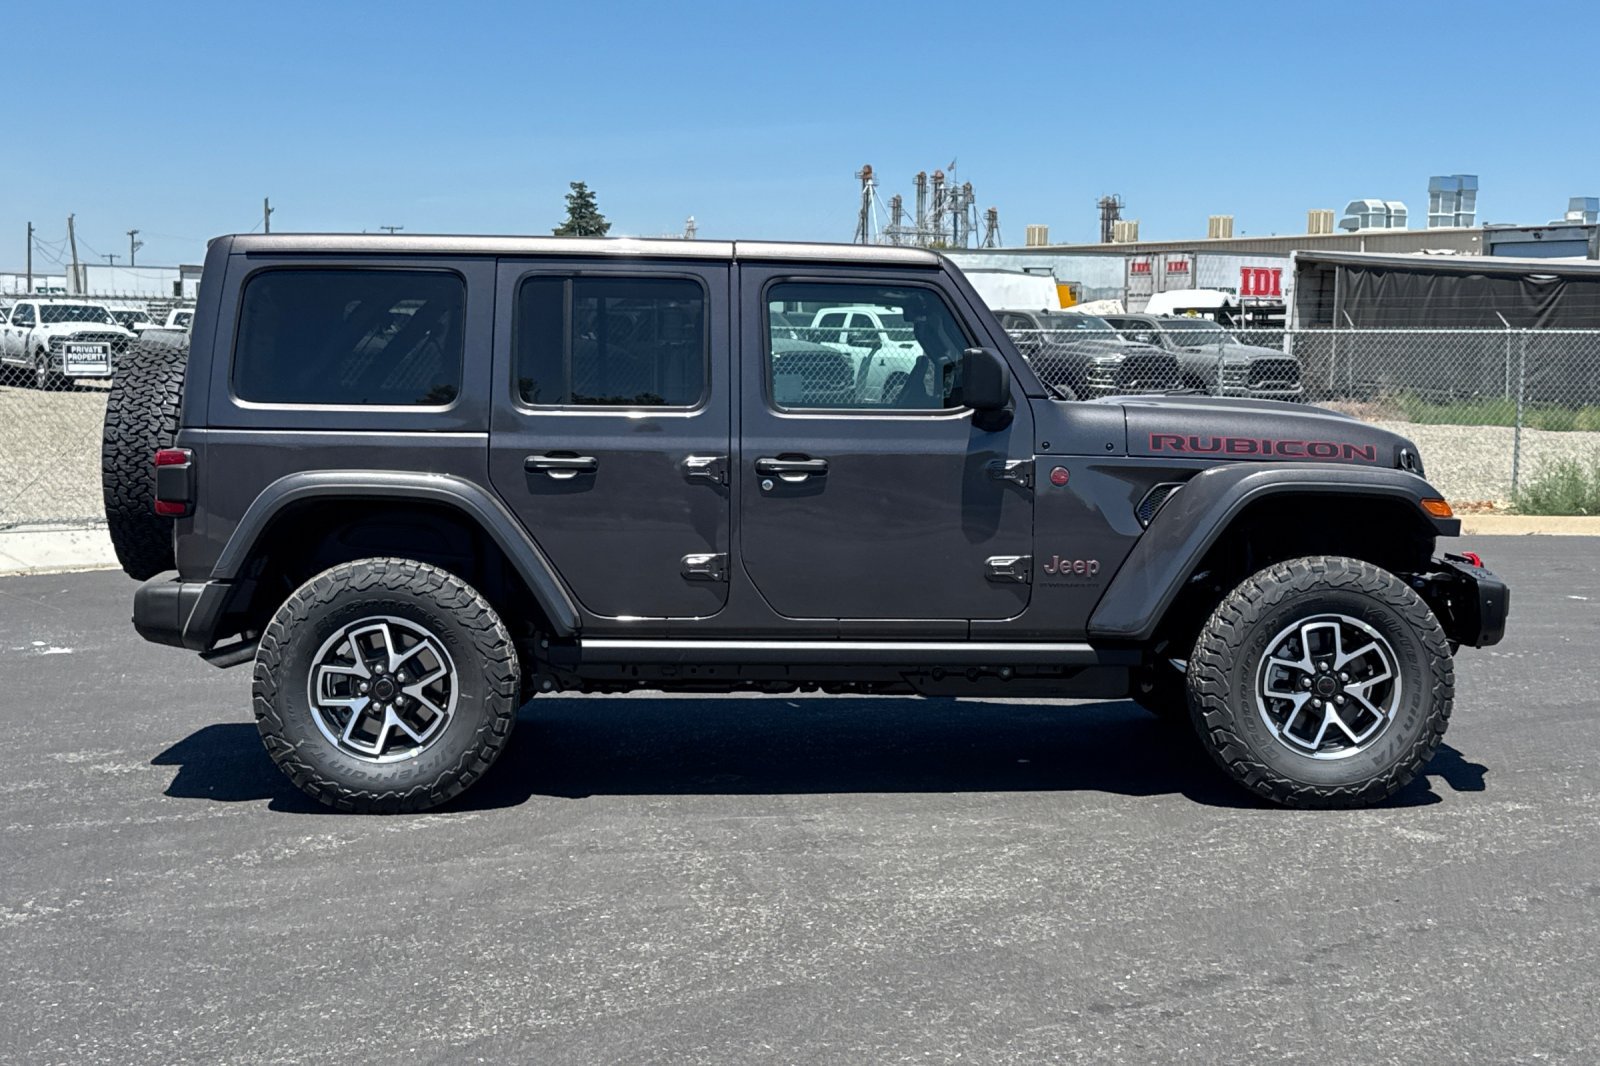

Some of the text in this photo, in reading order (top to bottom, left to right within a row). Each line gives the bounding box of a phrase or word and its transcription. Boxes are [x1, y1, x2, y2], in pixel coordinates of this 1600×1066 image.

[1131, 263, 1151, 272] IDI
[1167, 261, 1189, 271] IDI
[1240, 267, 1282, 297] IDI
[1149, 432, 1377, 461] RUBICON
[1043, 555, 1100, 577] Jeep
